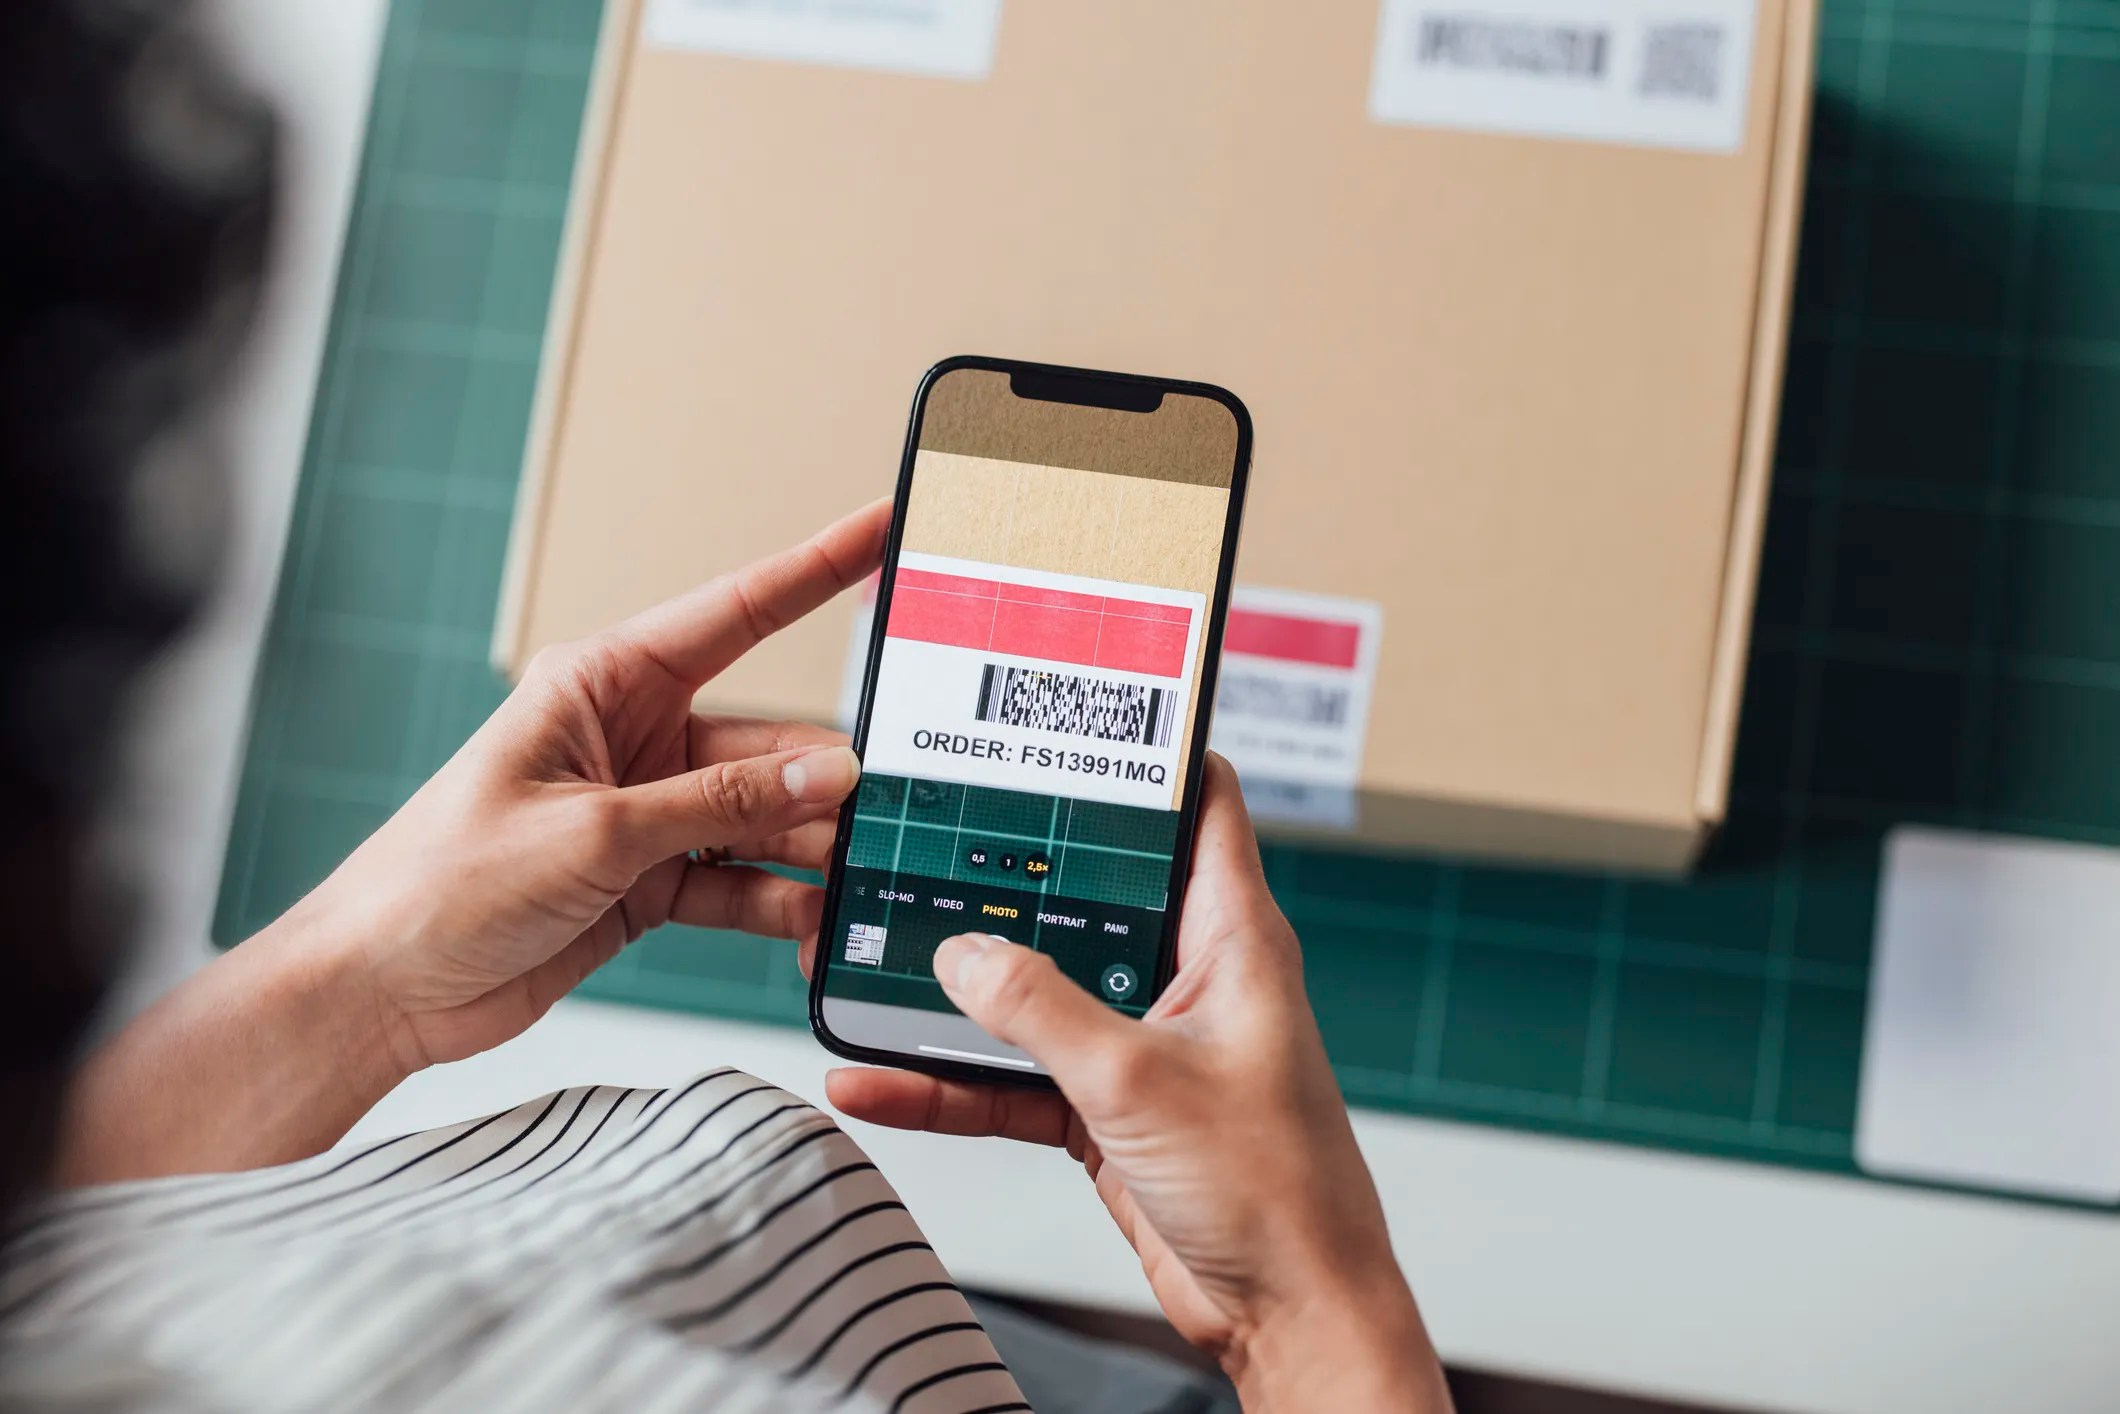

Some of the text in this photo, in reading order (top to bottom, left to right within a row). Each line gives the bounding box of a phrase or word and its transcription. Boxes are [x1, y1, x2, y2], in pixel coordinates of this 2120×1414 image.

[913, 730, 1166, 785] ORDER: FS13991MQ
[972, 854, 985, 863] 0,5
[878, 889, 914, 903] SLO-MO
[933, 898, 964, 911] VIDEO
[982, 905, 1018, 919] PHOTO
[1036, 913, 1087, 929] PORTRAIT
[1104, 922, 1129, 935] PANO
